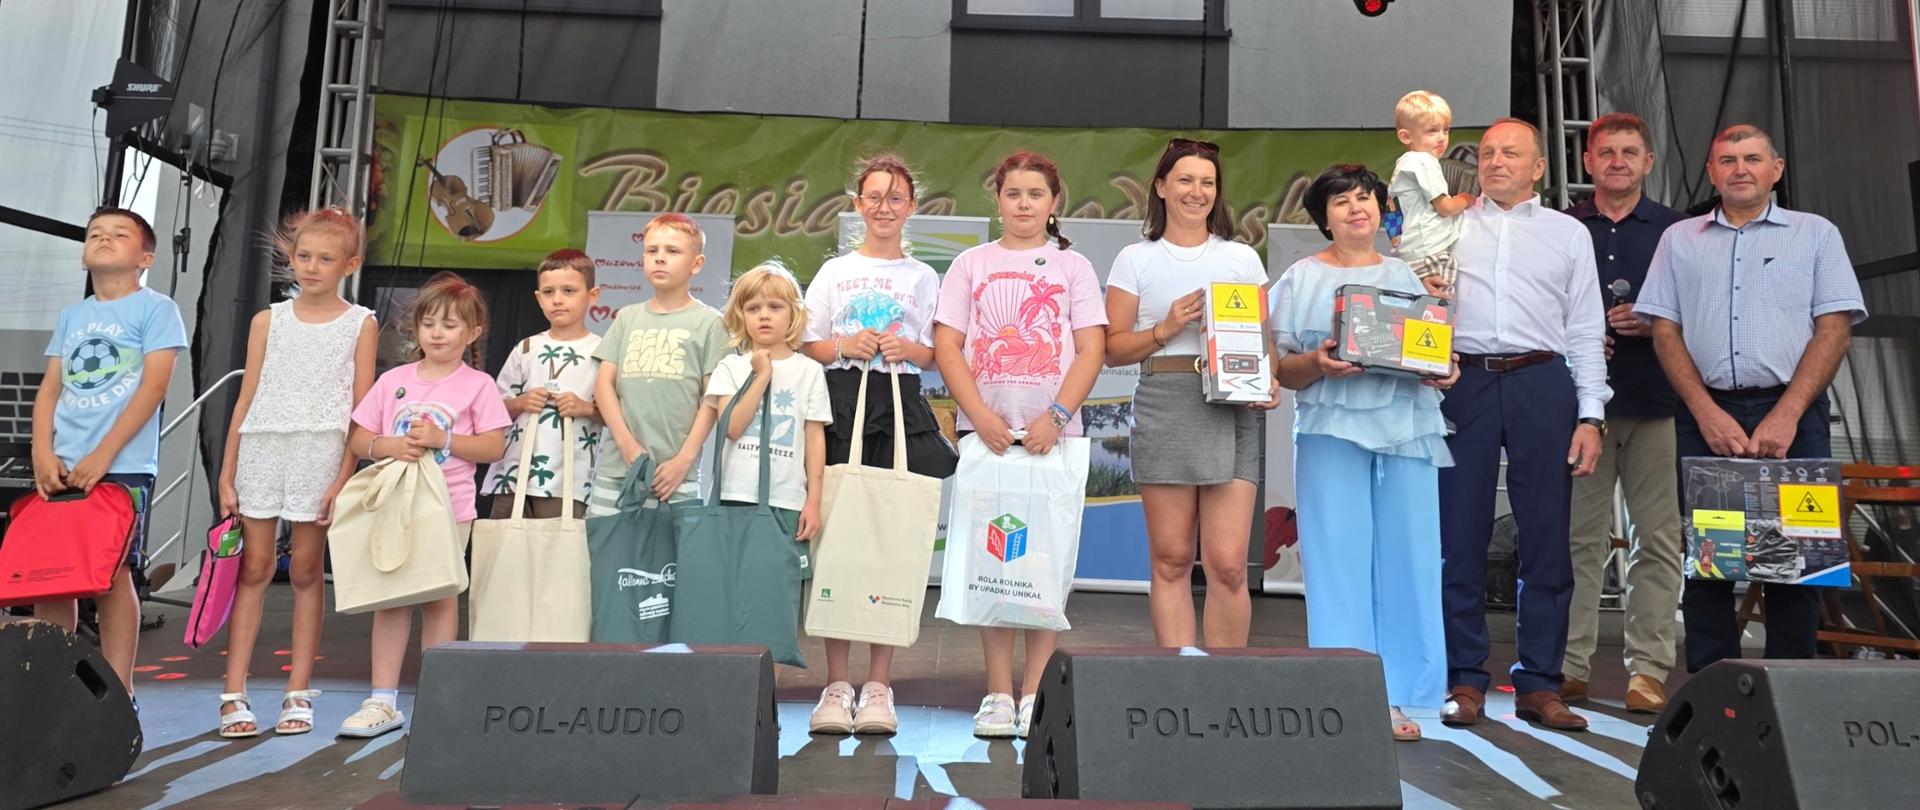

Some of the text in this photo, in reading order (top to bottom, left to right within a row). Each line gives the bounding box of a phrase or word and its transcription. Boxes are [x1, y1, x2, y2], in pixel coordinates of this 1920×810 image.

[87, 322, 125, 337] PLAY
[112, 367, 138, 398] DAY
[737, 442, 760, 452] SALTY
[768, 447, 794, 458] REEZE
[977, 575, 1033, 589] ROLA ROLNIKA
[968, 584, 1042, 600] BY UPADKU UNIKAŁ
[483, 705, 686, 737] POL-AUDIO
[1125, 706, 1345, 740] POL-AUDIO
